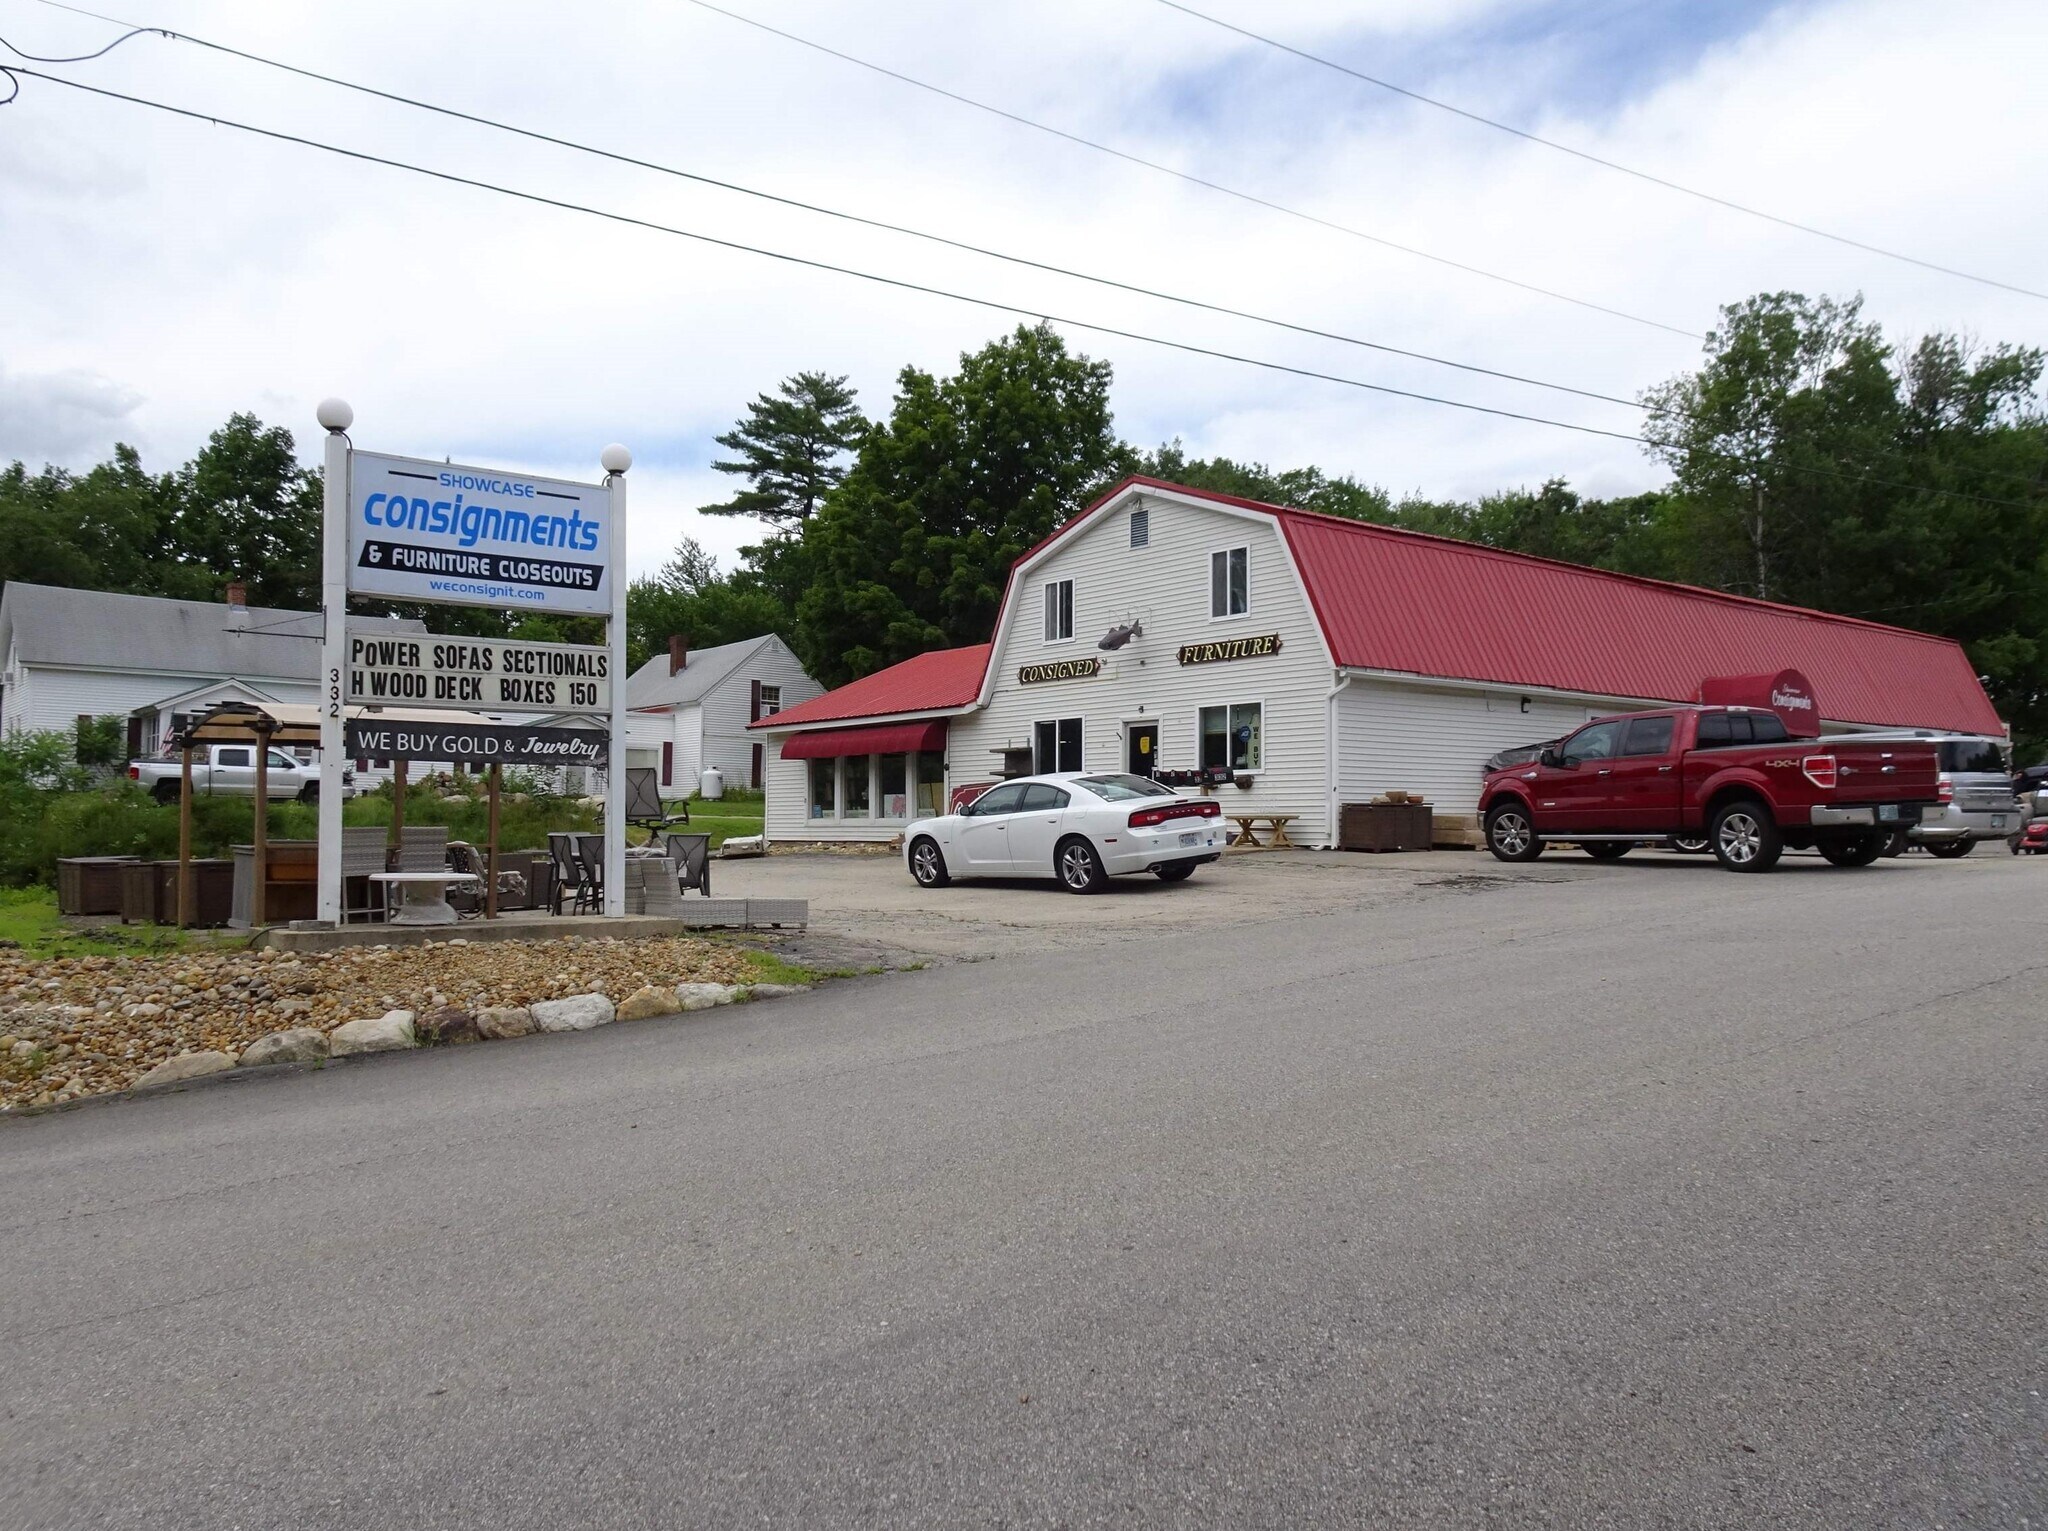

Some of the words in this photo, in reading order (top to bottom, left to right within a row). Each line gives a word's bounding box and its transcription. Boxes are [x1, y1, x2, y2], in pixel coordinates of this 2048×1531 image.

[440, 473, 534, 498] SHOWCASE
[364, 493, 599, 551] consignments
[368, 545, 382, 563] &
[392, 548, 490, 576] FURNITURE
[499, 560, 593, 586] CLOSEOUTS
[430, 580, 544, 600] weconsignit.com
[352, 638, 420, 667] POWER
[434, 644, 493, 671] SOFAS
[503, 650, 608, 678] SECTIONALS
[1183, 636, 1274, 664] FURNITURE
[1021, 659, 1094, 683] CONSIGNED
[329, 668, 339, 717] 332
[352, 671, 364, 695] H
[370, 672, 427, 698] WOOD
[435, 676, 482, 701] DECK
[500, 678, 555, 704] BOXES
[569, 682, 597, 706] 150
[358, 731, 391, 751] WE
[397, 733, 438, 752] BUY
[442, 735, 499, 755] GOLD
[504, 739, 515, 753] &
[521, 736, 600, 760] Jewelry
